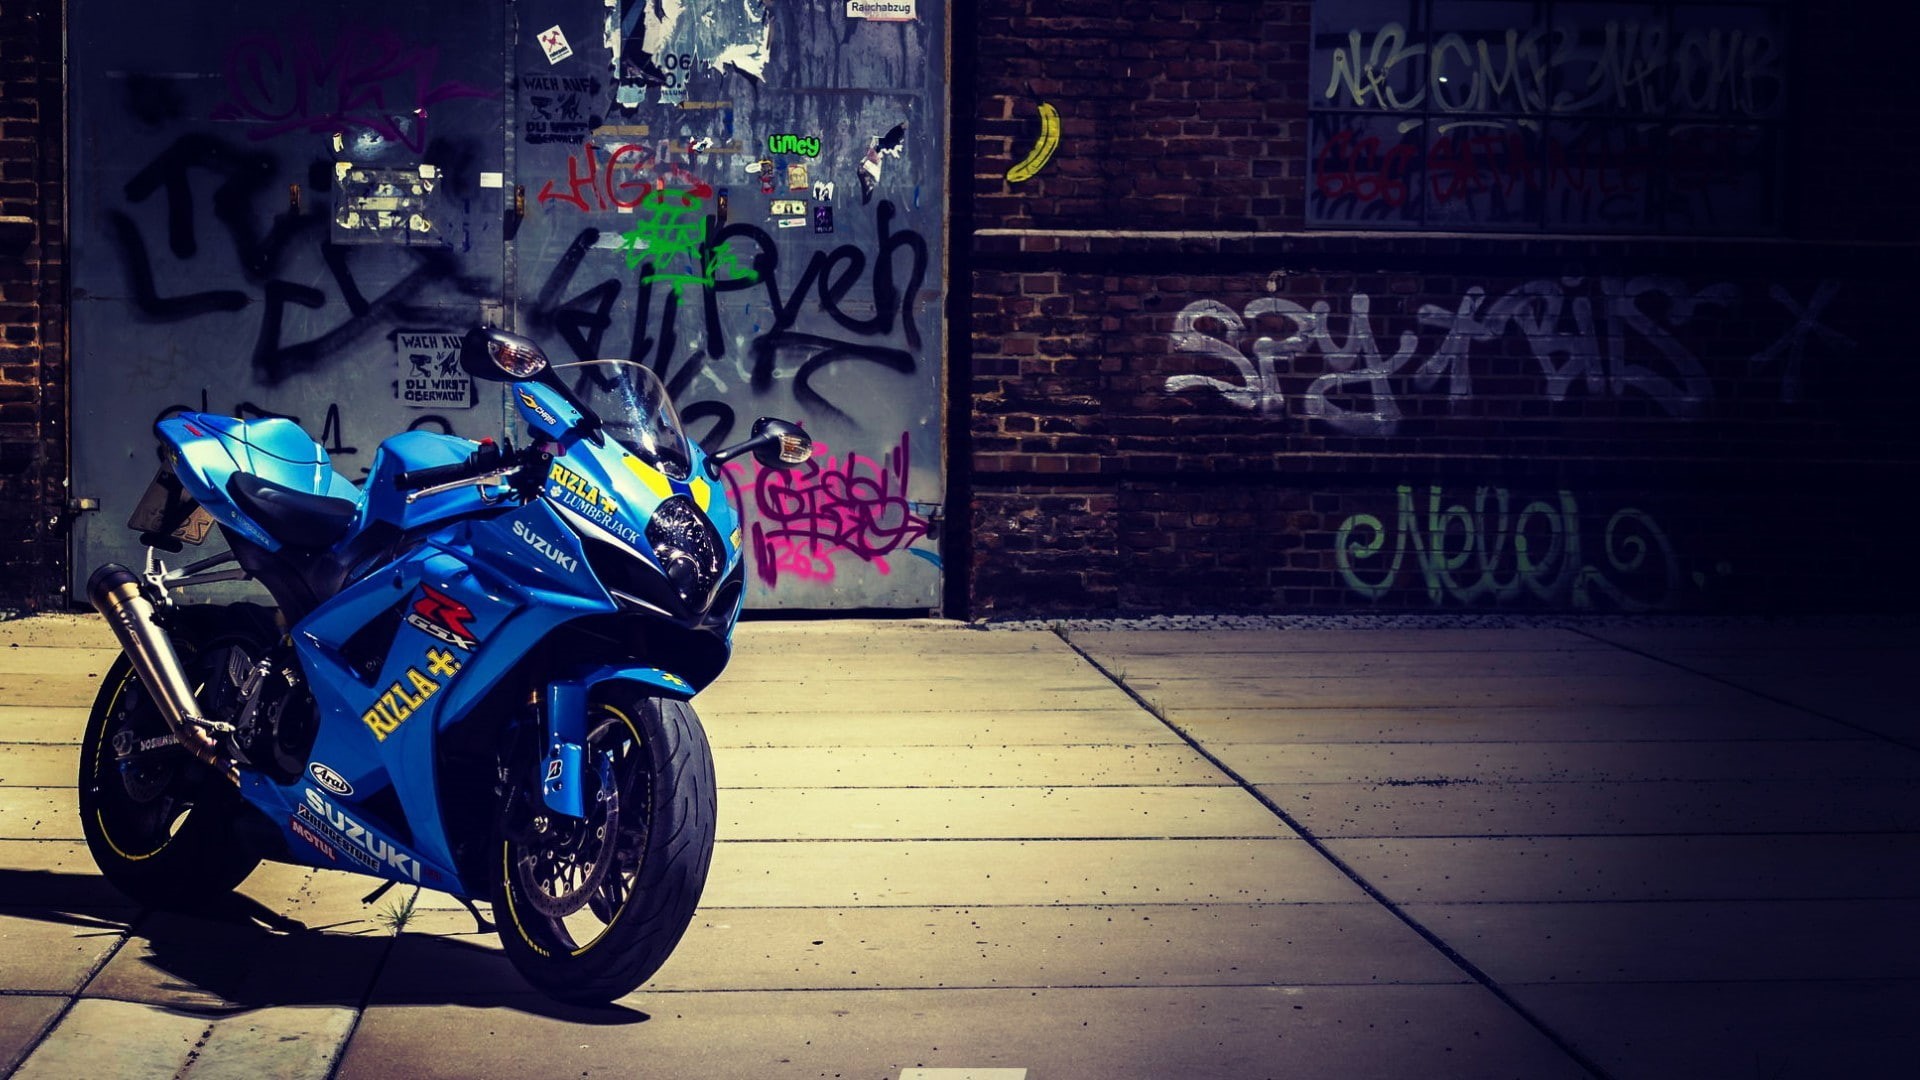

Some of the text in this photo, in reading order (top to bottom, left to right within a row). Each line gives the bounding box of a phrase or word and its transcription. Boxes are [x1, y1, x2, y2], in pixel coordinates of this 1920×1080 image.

[851, 1, 911, 14] Rauchabzug
[523, 77, 559, 90] WACH
[402, 335, 438, 349] WACH
[405, 379, 427, 390] DU
[562, 491, 641, 545] LUMBERJACK
[512, 519, 578, 574] SUZUKI
[407, 612, 479, 652] GSX
[361, 667, 441, 743] RIZLA
[312, 766, 347, 790] Arai
[291, 820, 337, 861] MOTUL
[305, 787, 421, 883] SUZUKI
